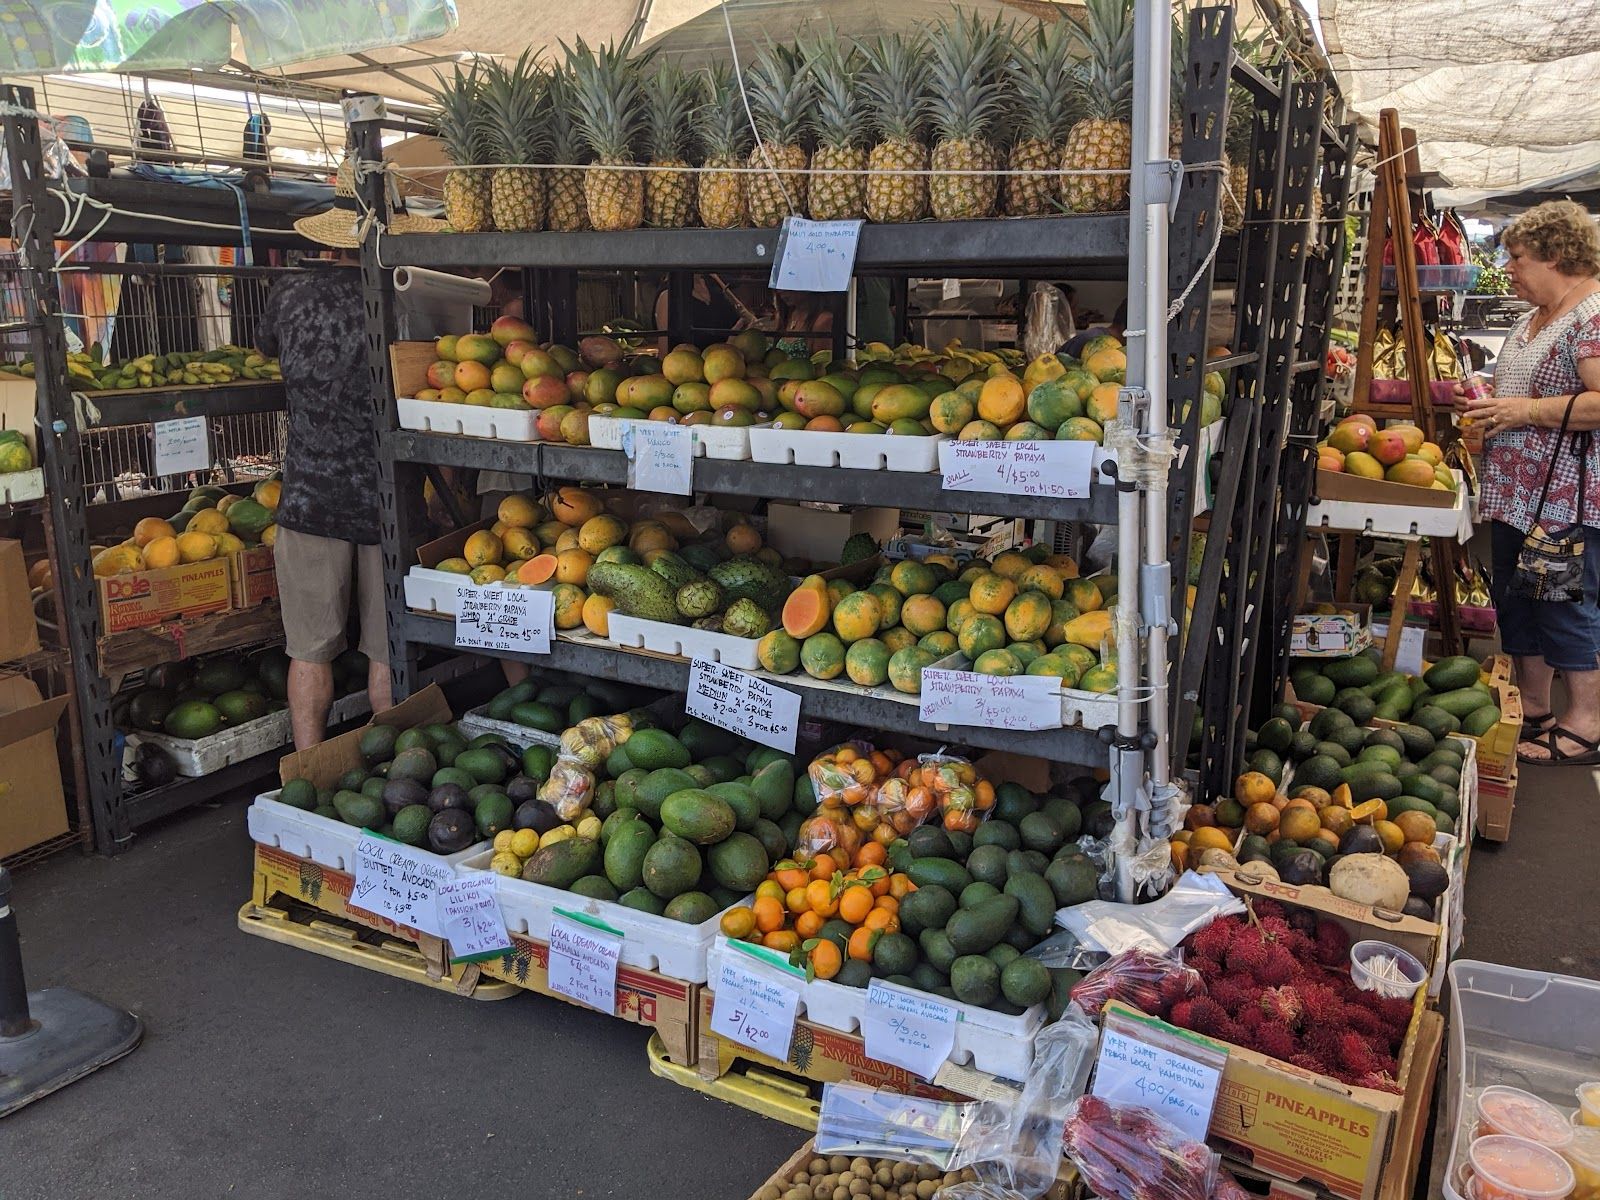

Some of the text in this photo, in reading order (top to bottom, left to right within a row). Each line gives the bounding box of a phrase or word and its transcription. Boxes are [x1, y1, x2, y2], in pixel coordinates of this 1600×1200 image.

[985, 441, 1012, 449] SWEET
[1016, 442, 1040, 451] LOCAL
[955, 449, 1046, 464] STRAWBERRY PAPAYA
[945, 469, 970, 486] SMALL
[181, 567, 225, 584] PINEAPPLES
[106, 576, 150, 599] Dole
[483, 589, 504, 601] SWEET
[507, 591, 529, 603] LOCAL
[462, 599, 527, 617] STRAWBERRY PAPAYA
[460, 611, 481, 619] JUMBO
[497, 614, 519, 625] GRADE
[505, 631, 520, 640] FOR
[721, 668, 745, 684] SWEET
[748, 678, 773, 696] LOCAL
[954, 671, 979, 683] SWEET
[986, 675, 1013, 686] LOCAL
[699, 672, 773, 709] STRAWBERRY PAPAYA
[929, 681, 1025, 699] STRAWBERRY PAPAYA
[713, 702, 737, 715] $2.00
[754, 723, 769, 733] FOR
[744, 703, 773, 719] GRADE
[358, 840, 450, 880] LOCAL CREAMY ORGANIC
[362, 857, 436, 890] BUTTER AVOCADO
[389, 886, 402, 898] FOR
[438, 876, 495, 896] LOCAL ORGANIC
[449, 890, 480, 904] LILIKOI
[551, 923, 570, 941] LOCAL
[582, 953, 610, 971] AVOCADO
[765, 984, 782, 997] LOCAL
[869, 988, 896, 1008] RIPE
[1106, 1035, 1204, 1077] VERY SWEET ORGANIC
[1130, 1056, 1152, 1071] LOCAL
[1158, 1065, 1205, 1090] RAMBUTAN
[1264, 1090, 1370, 1138] PINEAPPLES
[1286, 1140, 1333, 1161] PINEAPPLES
[1294, 1148, 1325, 1163] ANANAS
